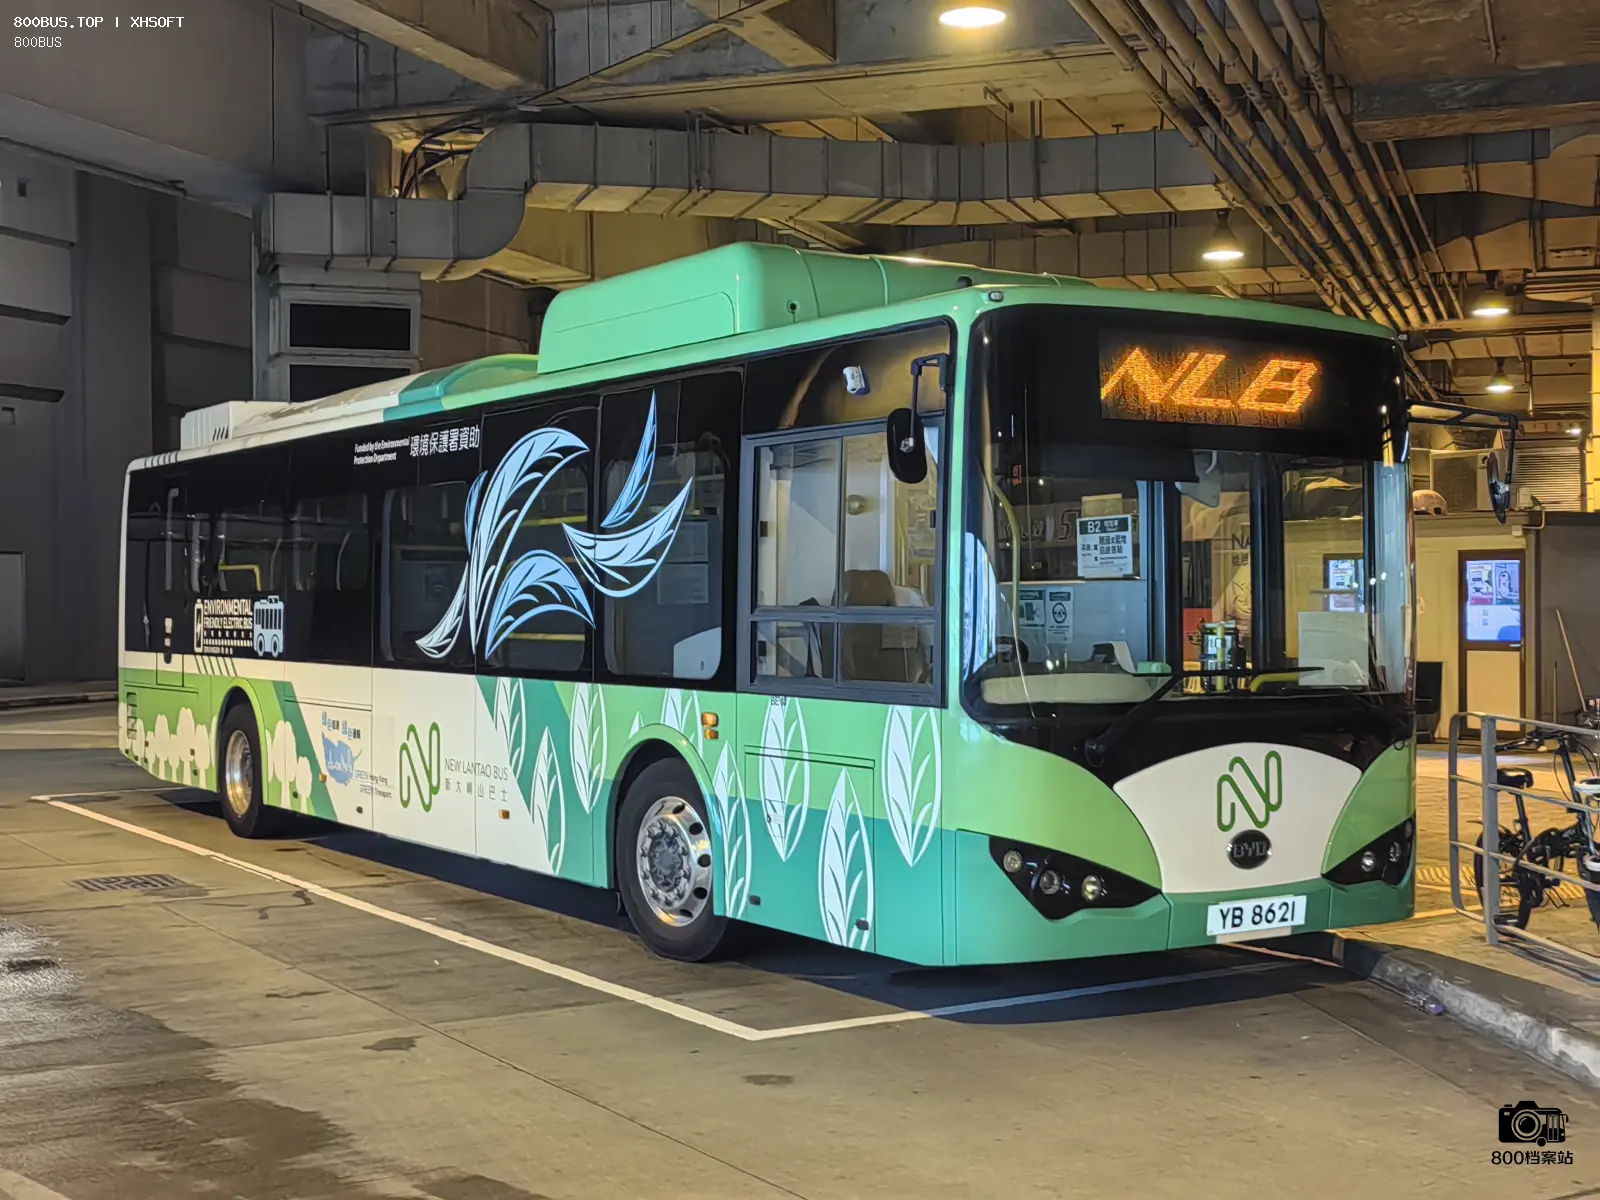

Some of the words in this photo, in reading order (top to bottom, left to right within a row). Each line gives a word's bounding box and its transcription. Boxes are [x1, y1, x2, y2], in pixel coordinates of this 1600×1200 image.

[1101, 347, 1319, 413] NLB
[381, 436, 411, 450] Environmental
[409, 424, 480, 457] 環境保護署資助
[373, 452, 397, 464] Department
[1087, 520, 1101, 534] B2
[203, 599, 253, 615] ENVIRONMENTAL
[203, 617, 223, 629] FRIENDLY
[223, 617, 243, 629] ELECTRIC
[243, 617, 253, 630] BUS
[444, 757, 461, 772] NEW
[462, 761, 492, 778] LANTAO
[493, 765, 509, 781] BUS
[1233, 841, 1268, 859] BYD
[1219, 906, 1244, 930] YB
[1251, 900, 1297, 926] 8621
